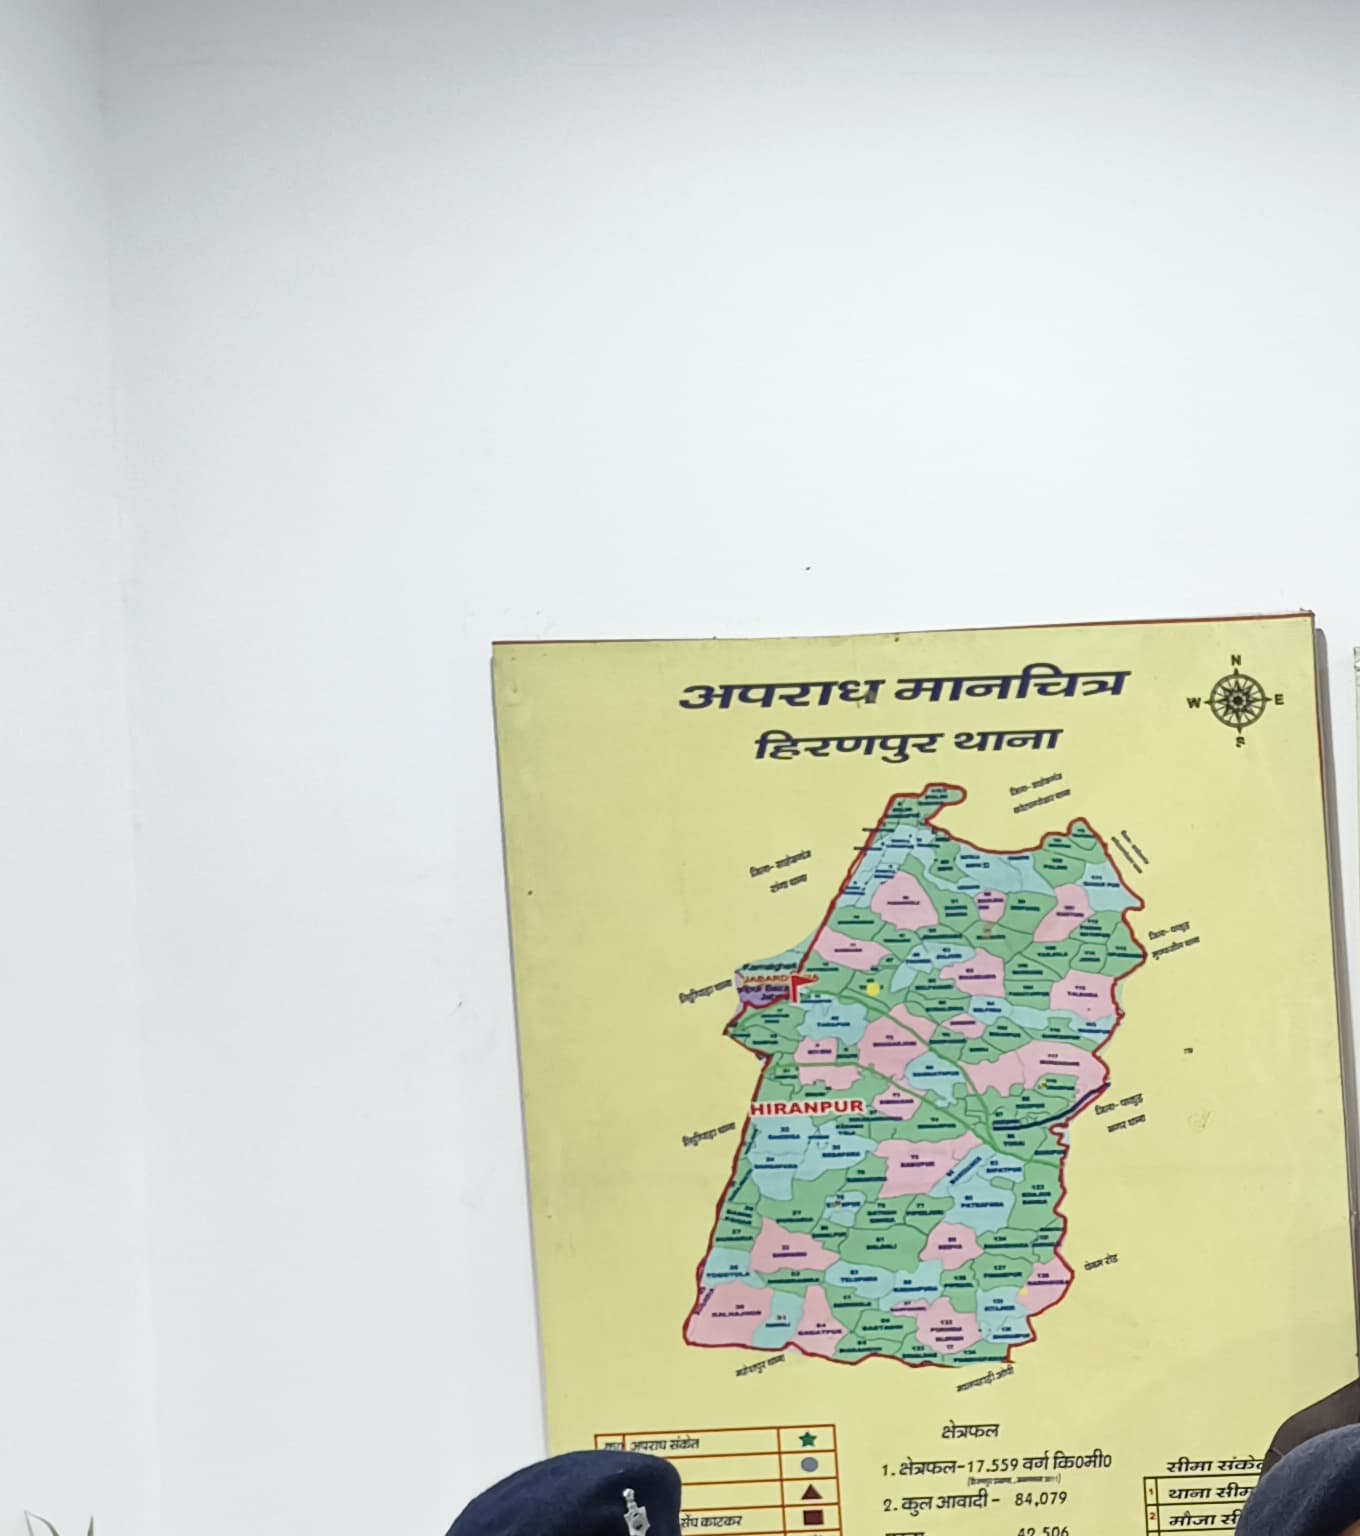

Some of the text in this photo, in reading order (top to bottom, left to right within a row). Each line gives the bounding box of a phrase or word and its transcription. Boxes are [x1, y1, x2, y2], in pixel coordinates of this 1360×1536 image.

[1231, 654, 1241, 666] N
[679, 664, 1131, 711] अपराध मानचित्र
[1186, 697, 1201, 709] W
[1274, 693, 1284, 705] E
[754, 726, 1064, 763] हिरणपुर थाना
[751, 1100, 864, 1115] HIRANPUR
[942, 1420, 999, 1439] क्षेत्रफल
[1023, 1451, 1048, 1470] वर्ग
[1167, 1456, 1212, 1473] सीमा
[1168, 1487, 1211, 1499] थाना
[901, 1497, 933, 1517] कुल
[1015, 1491, 1068, 1508] 84,079
[1169, 1511, 1216, 1526] मौजा
